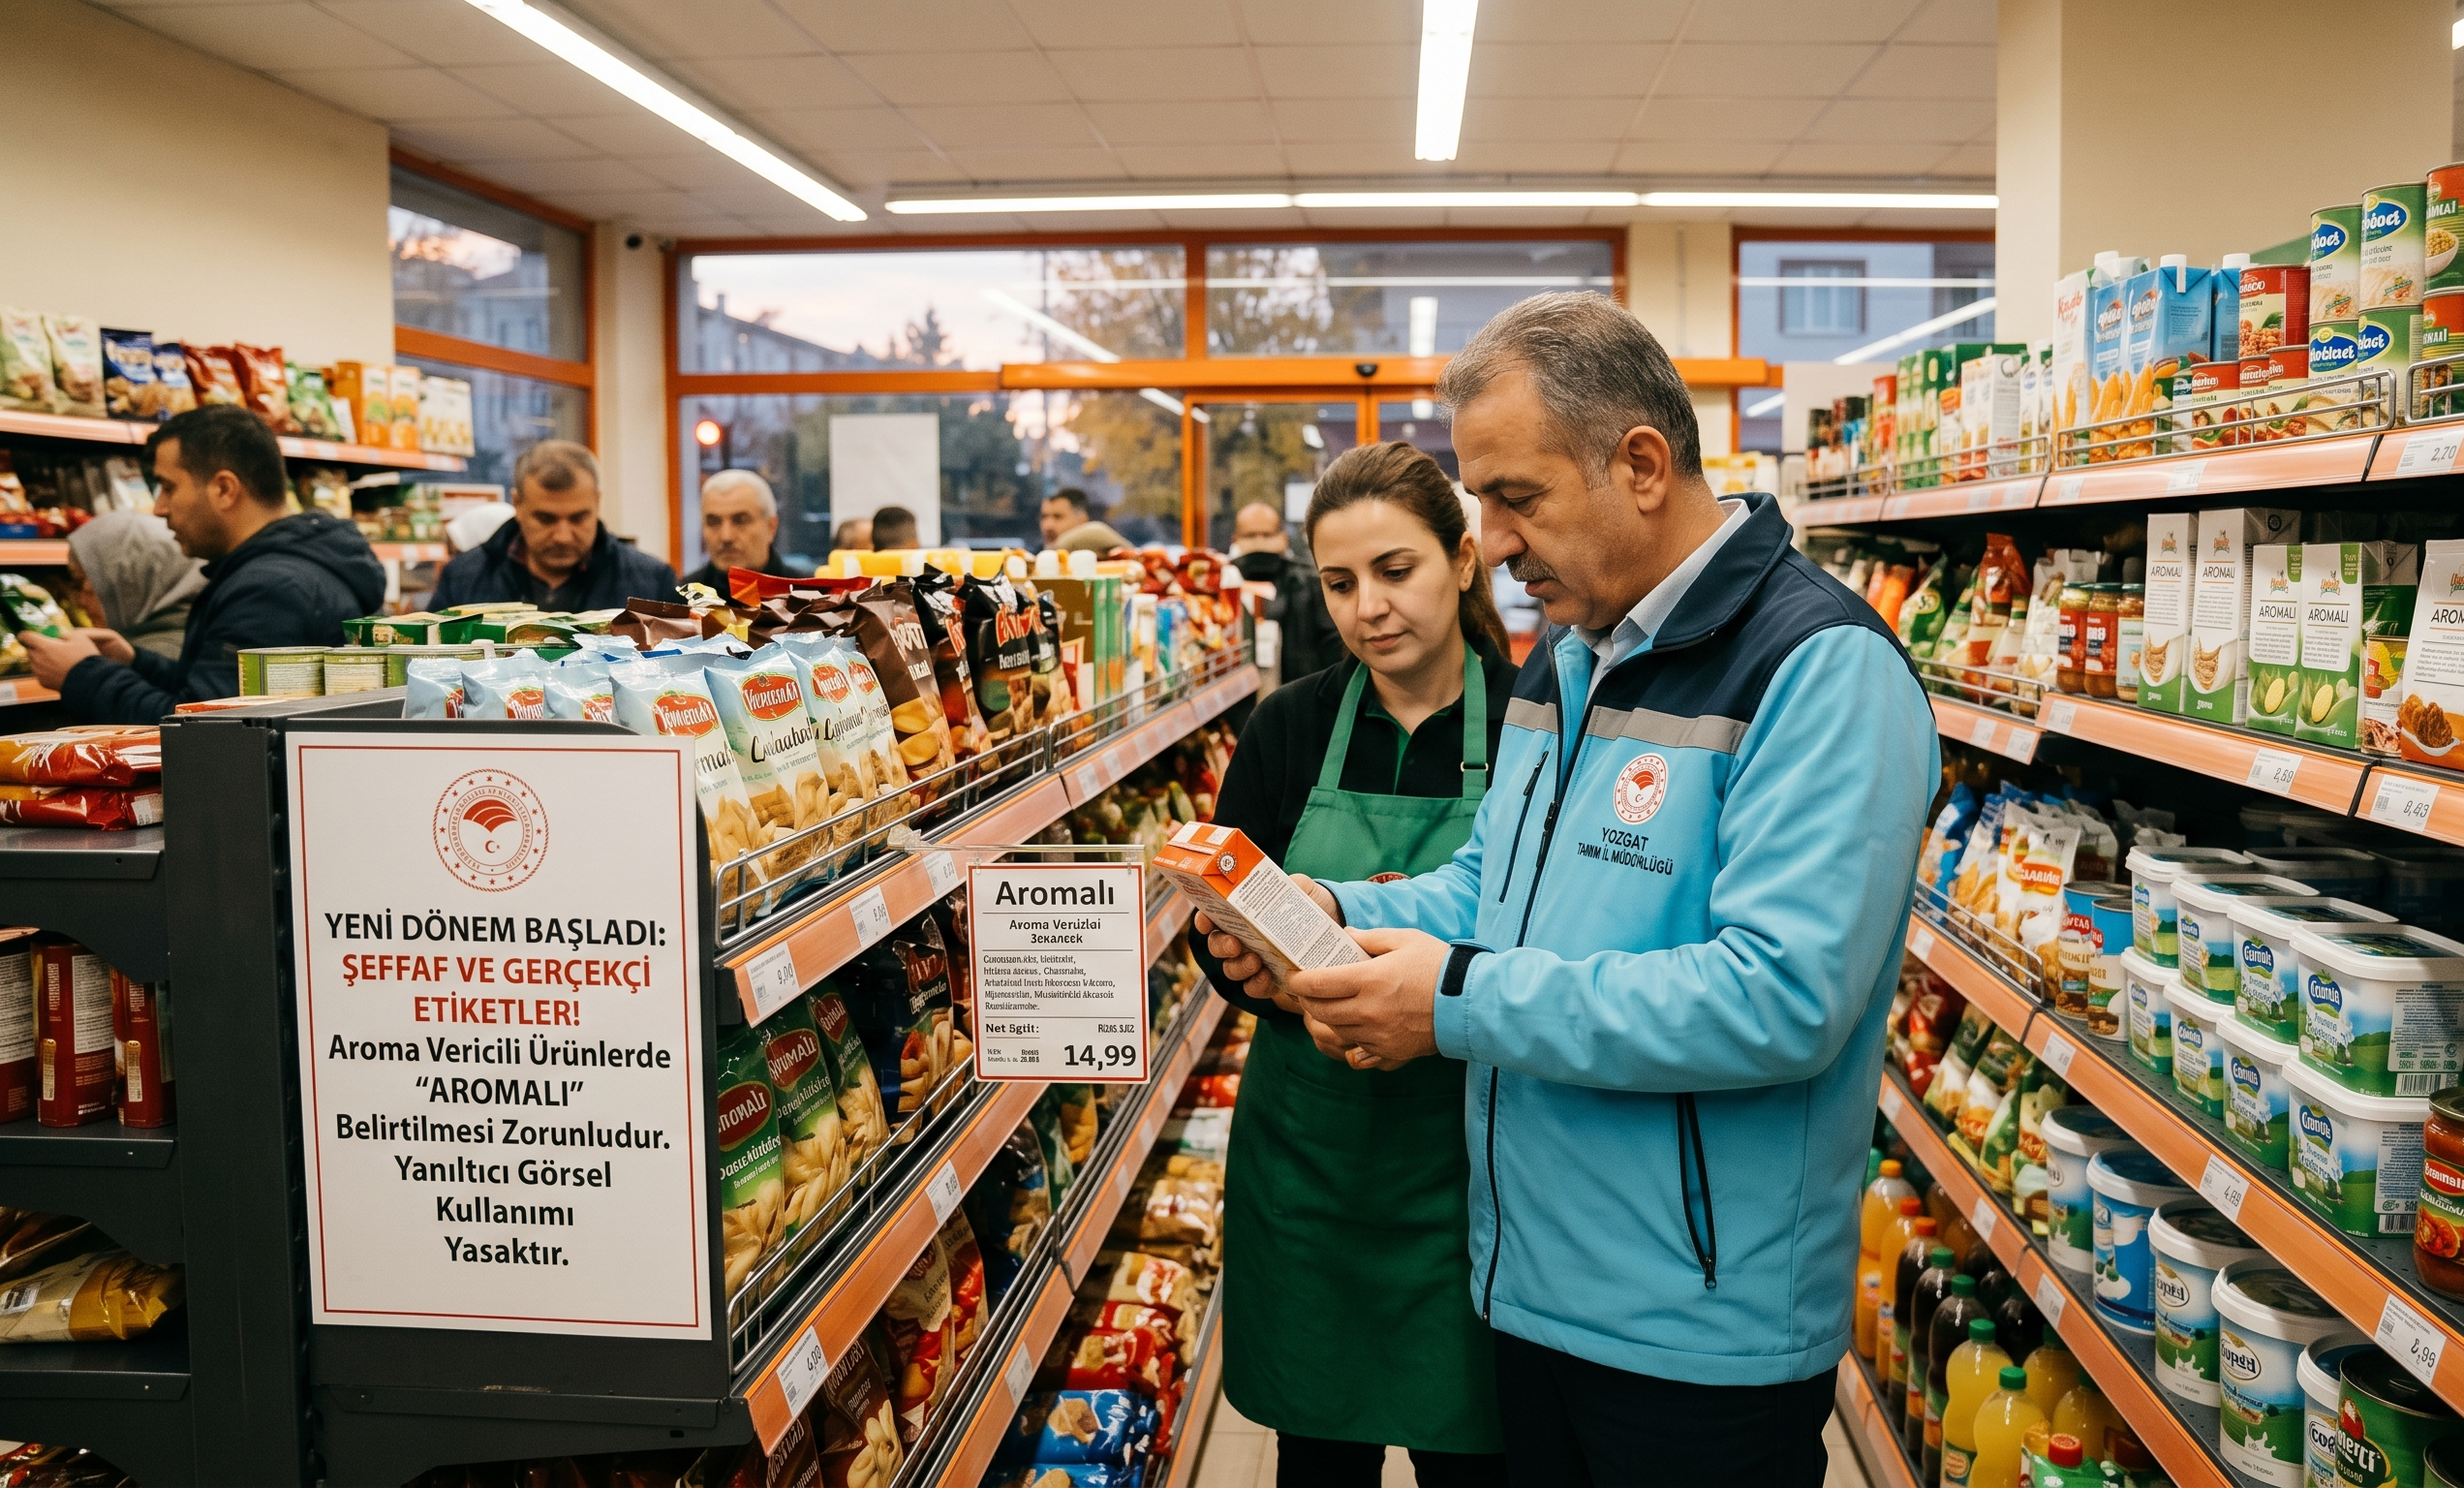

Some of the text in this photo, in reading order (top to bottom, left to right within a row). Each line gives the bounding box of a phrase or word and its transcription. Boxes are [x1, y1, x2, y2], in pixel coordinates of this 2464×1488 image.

[1602, 827, 1648, 852] YOZGAT
[995, 880, 1114, 906] Aromalı
[324, 909, 665, 951] YENİ DÖNEM BAŞLADI:
[342, 954, 651, 994] ŞEFFAF VE GERÇEKÇİ
[414, 991, 581, 1026] ETİKETLER!
[986, 1024, 1005, 1033] Net
[329, 1034, 671, 1069] Aroma Vericili Ürünlerde
[1063, 1044, 1137, 1070] 14,99
[336, 1114, 670, 1150] Belirtilmesi Zorunludur.
[394, 1155, 611, 1188] Yanıltıcı Görsel
[437, 1196, 573, 1226] Kullanımı
[445, 1236, 570, 1266] Yasaktır.
